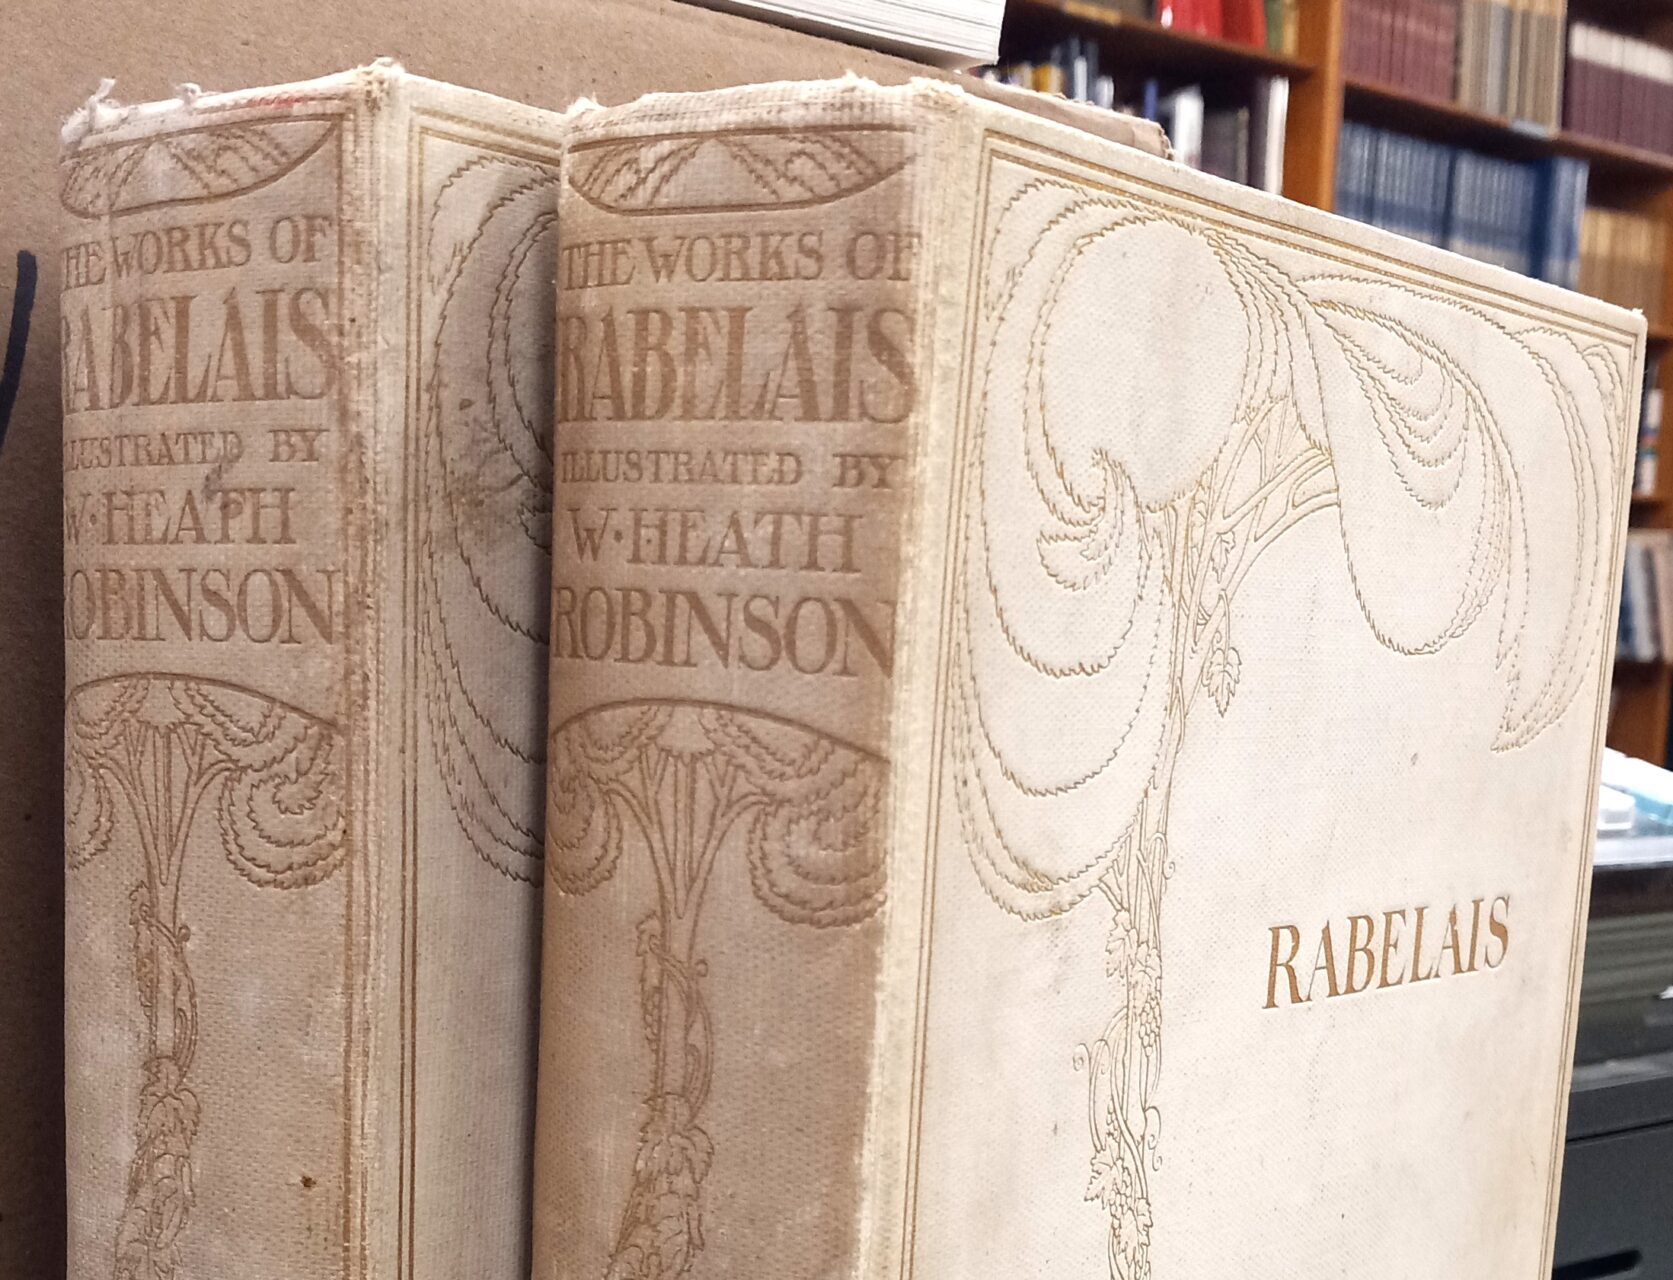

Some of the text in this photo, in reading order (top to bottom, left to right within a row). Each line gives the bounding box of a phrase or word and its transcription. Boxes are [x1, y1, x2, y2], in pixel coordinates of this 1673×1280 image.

[62, 213, 333, 290] HE WORKS OF
[561, 230, 921, 291] THE WORKS OF
[557, 305, 916, 425] RABELAIS
[268, 428, 329, 464] BY
[561, 449, 909, 490] ILLUSTRATED BY
[65, 566, 341, 646] OBINSON
[553, 584, 899, 680] ROBINSON
[1262, 895, 1510, 1009] RABELAIS
